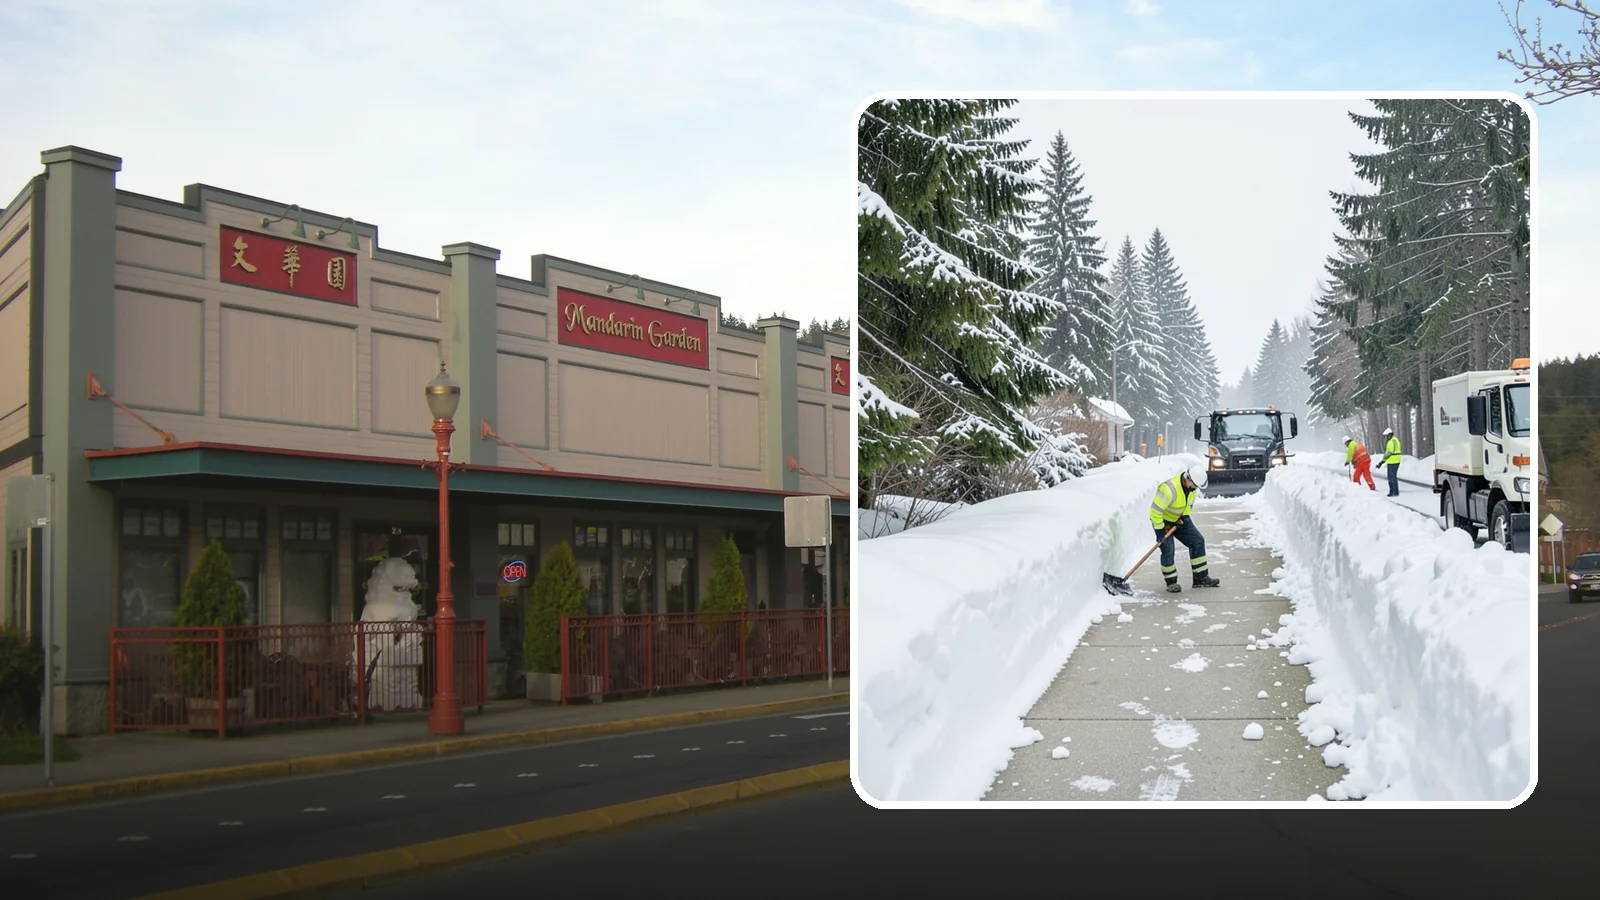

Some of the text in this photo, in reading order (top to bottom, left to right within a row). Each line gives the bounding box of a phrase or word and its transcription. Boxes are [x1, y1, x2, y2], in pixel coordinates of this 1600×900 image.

[230, 235, 346, 291] 文華園
[564, 302, 702, 352] Mandarin Garden
[834, 363, 846, 386] 文
[503, 564, 527, 578] OPEN
